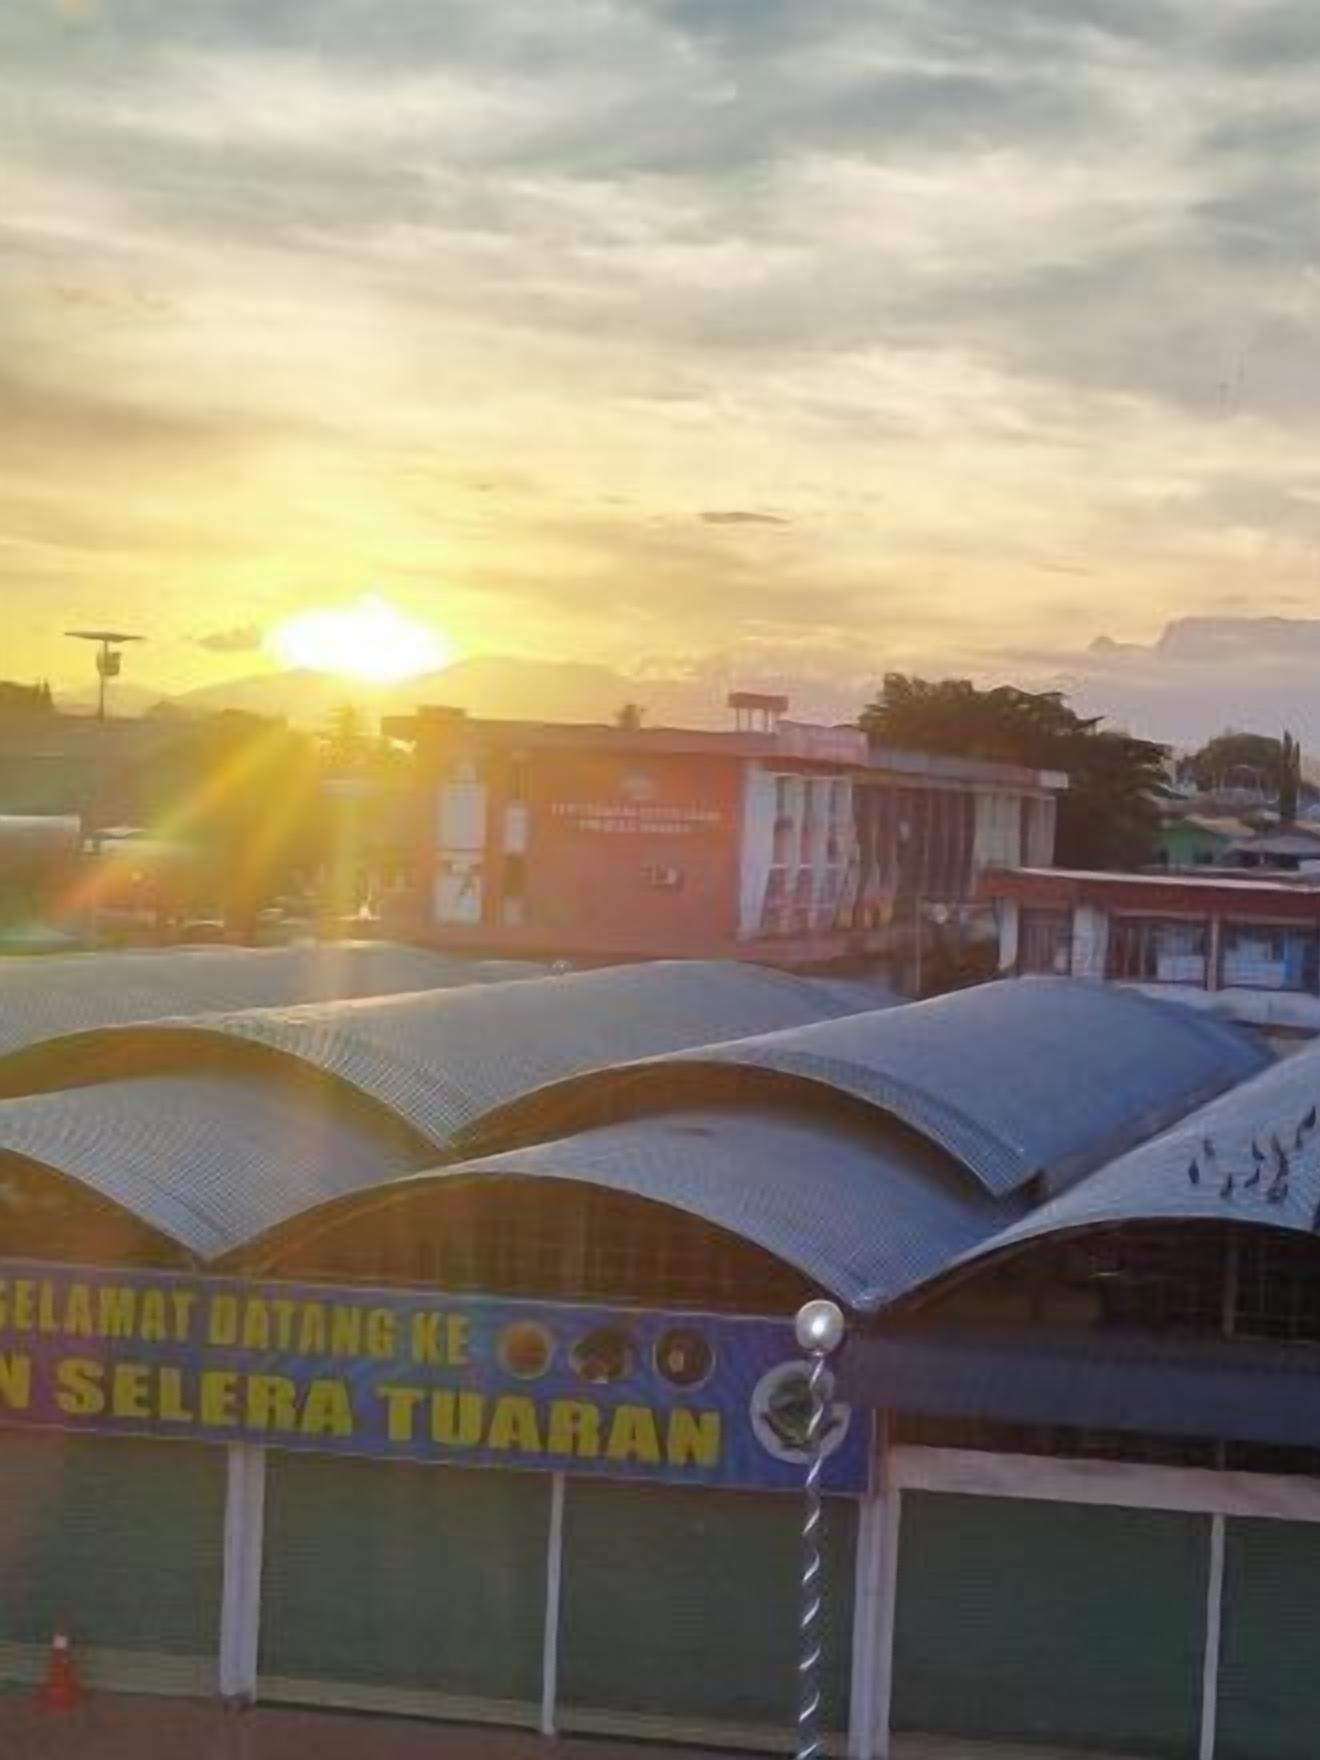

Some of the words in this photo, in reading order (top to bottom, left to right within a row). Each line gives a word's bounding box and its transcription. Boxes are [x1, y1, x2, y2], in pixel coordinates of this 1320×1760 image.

[208, 1295, 396, 1360] DATANG
[411, 1311, 471, 1366] KE
[56, 1357, 353, 1437] SELERA
[378, 1386, 721, 1467] TUARAN
